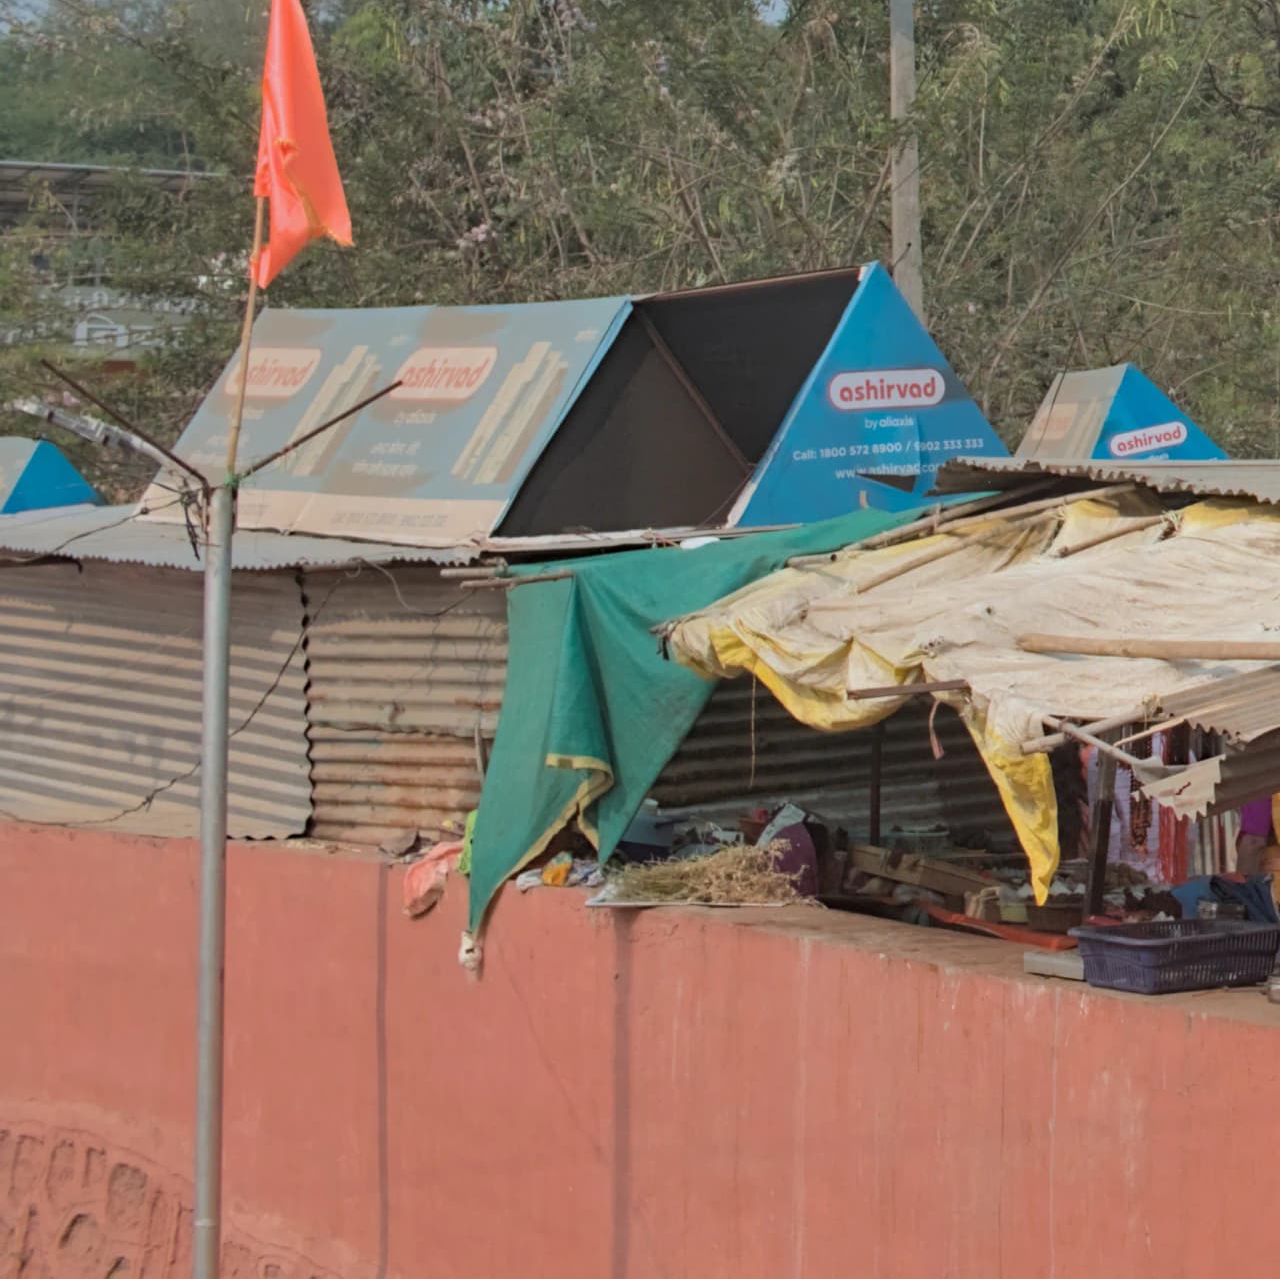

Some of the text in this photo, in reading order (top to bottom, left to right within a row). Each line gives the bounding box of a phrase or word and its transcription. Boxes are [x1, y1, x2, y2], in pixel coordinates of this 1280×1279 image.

[839, 377, 936, 402] ashirvad
[820, 447, 847, 458] 1800
[850, 445, 869, 456] 572
[1117, 426, 1181, 452] ashirvad
